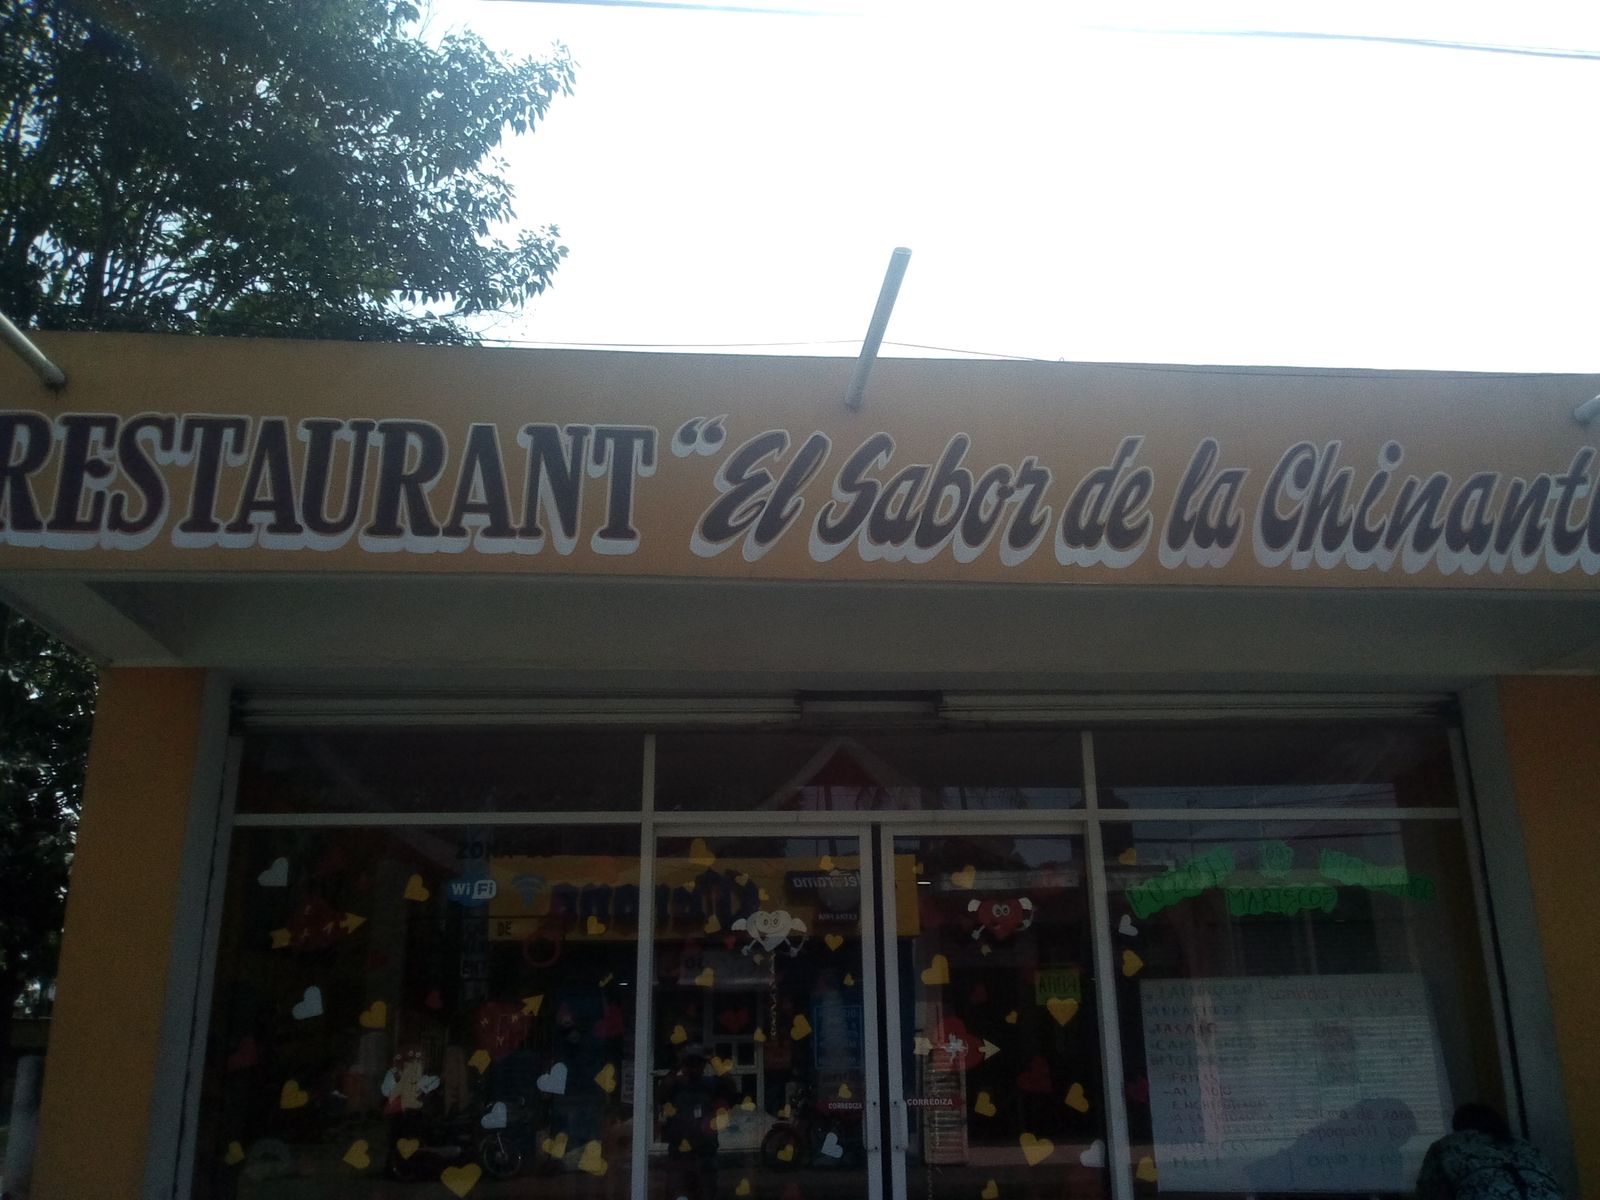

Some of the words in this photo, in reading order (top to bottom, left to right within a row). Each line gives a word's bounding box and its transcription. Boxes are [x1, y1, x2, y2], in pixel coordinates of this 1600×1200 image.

[0, 409, 657, 556] RESTAURANT
[808, 432, 1052, 567] Sabor
[1054, 435, 1155, 569] de
[1158, 437, 1252, 569] la
[1227, 886, 1337, 914] MARISCOS
[907, 1098, 954, 1107] CORREDIZA
